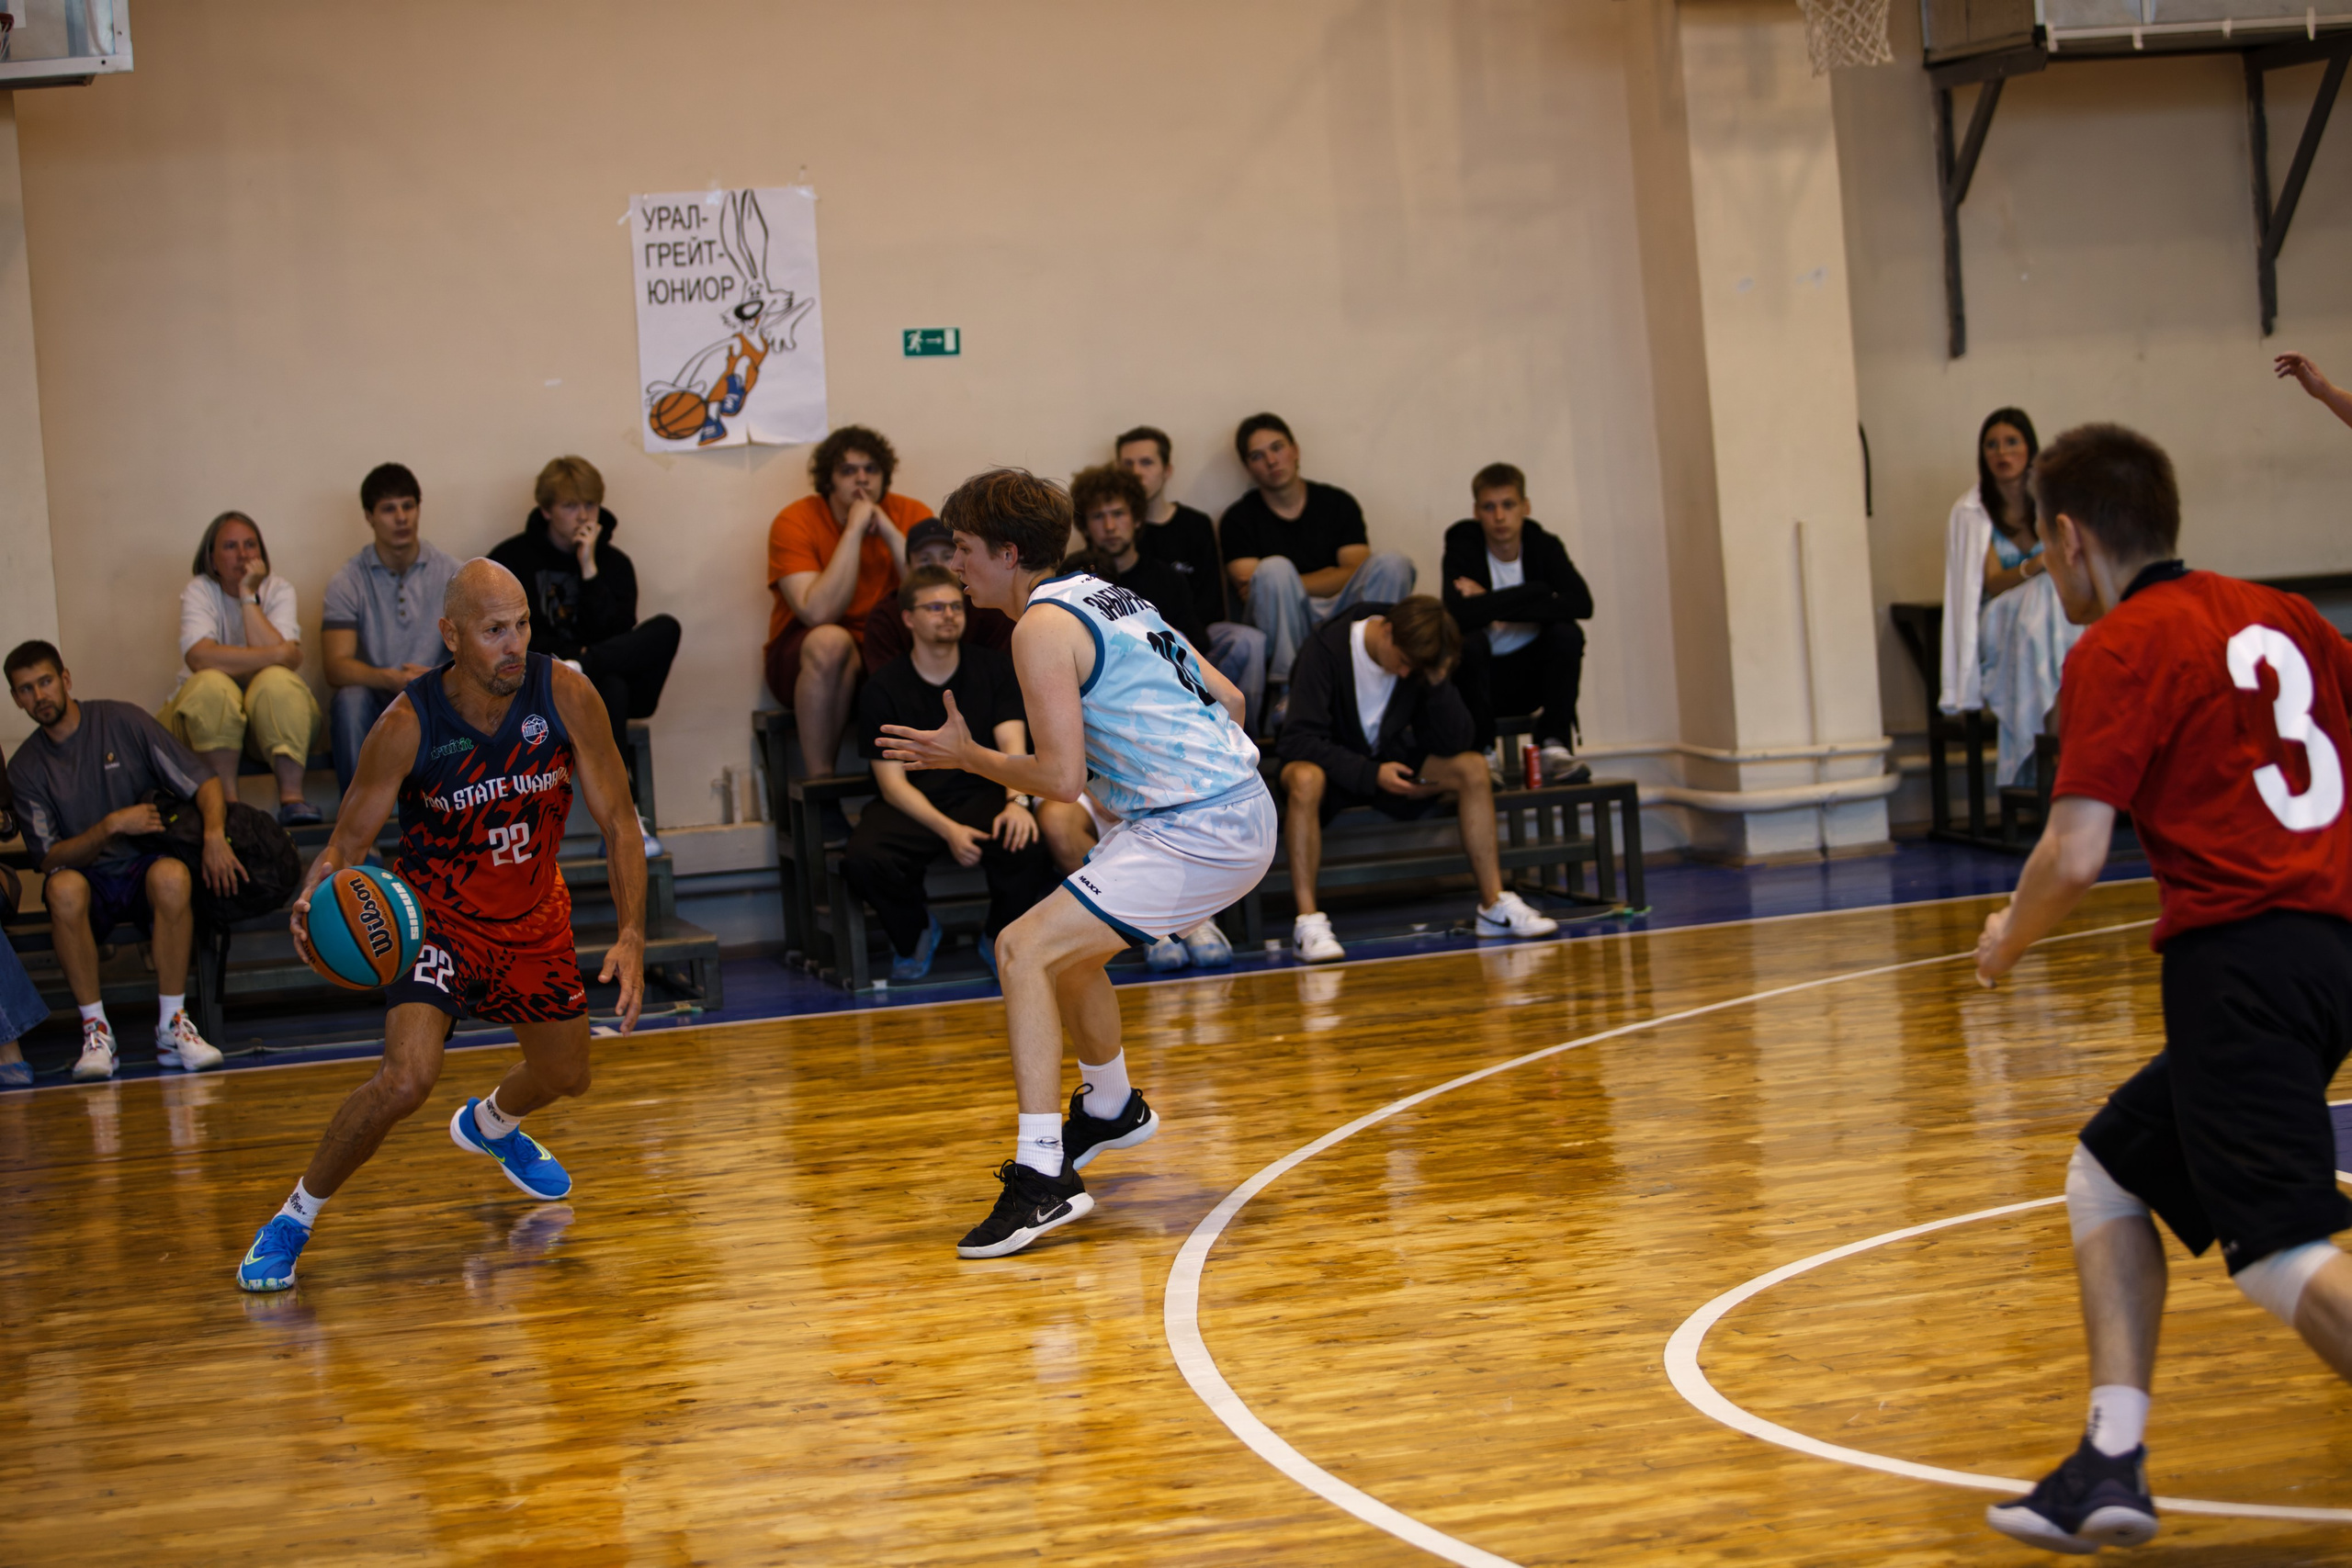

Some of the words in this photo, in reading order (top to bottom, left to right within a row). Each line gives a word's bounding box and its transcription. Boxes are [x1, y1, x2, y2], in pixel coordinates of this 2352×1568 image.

[642, 204, 708, 232] УРАЛ-
[646, 236, 724, 268] ГРЕЙТ-
[648, 276, 734, 305] ЮНИОР
[2226, 623, 2345, 832] 3
[453, 777, 506, 811] STATE
[488, 822, 532, 866] 22
[1079, 875, 1102, 896] MAXX
[348, 876, 394, 958] Wilson
[390, 882, 420, 941] SIBUR
[413, 944, 455, 993] 22
